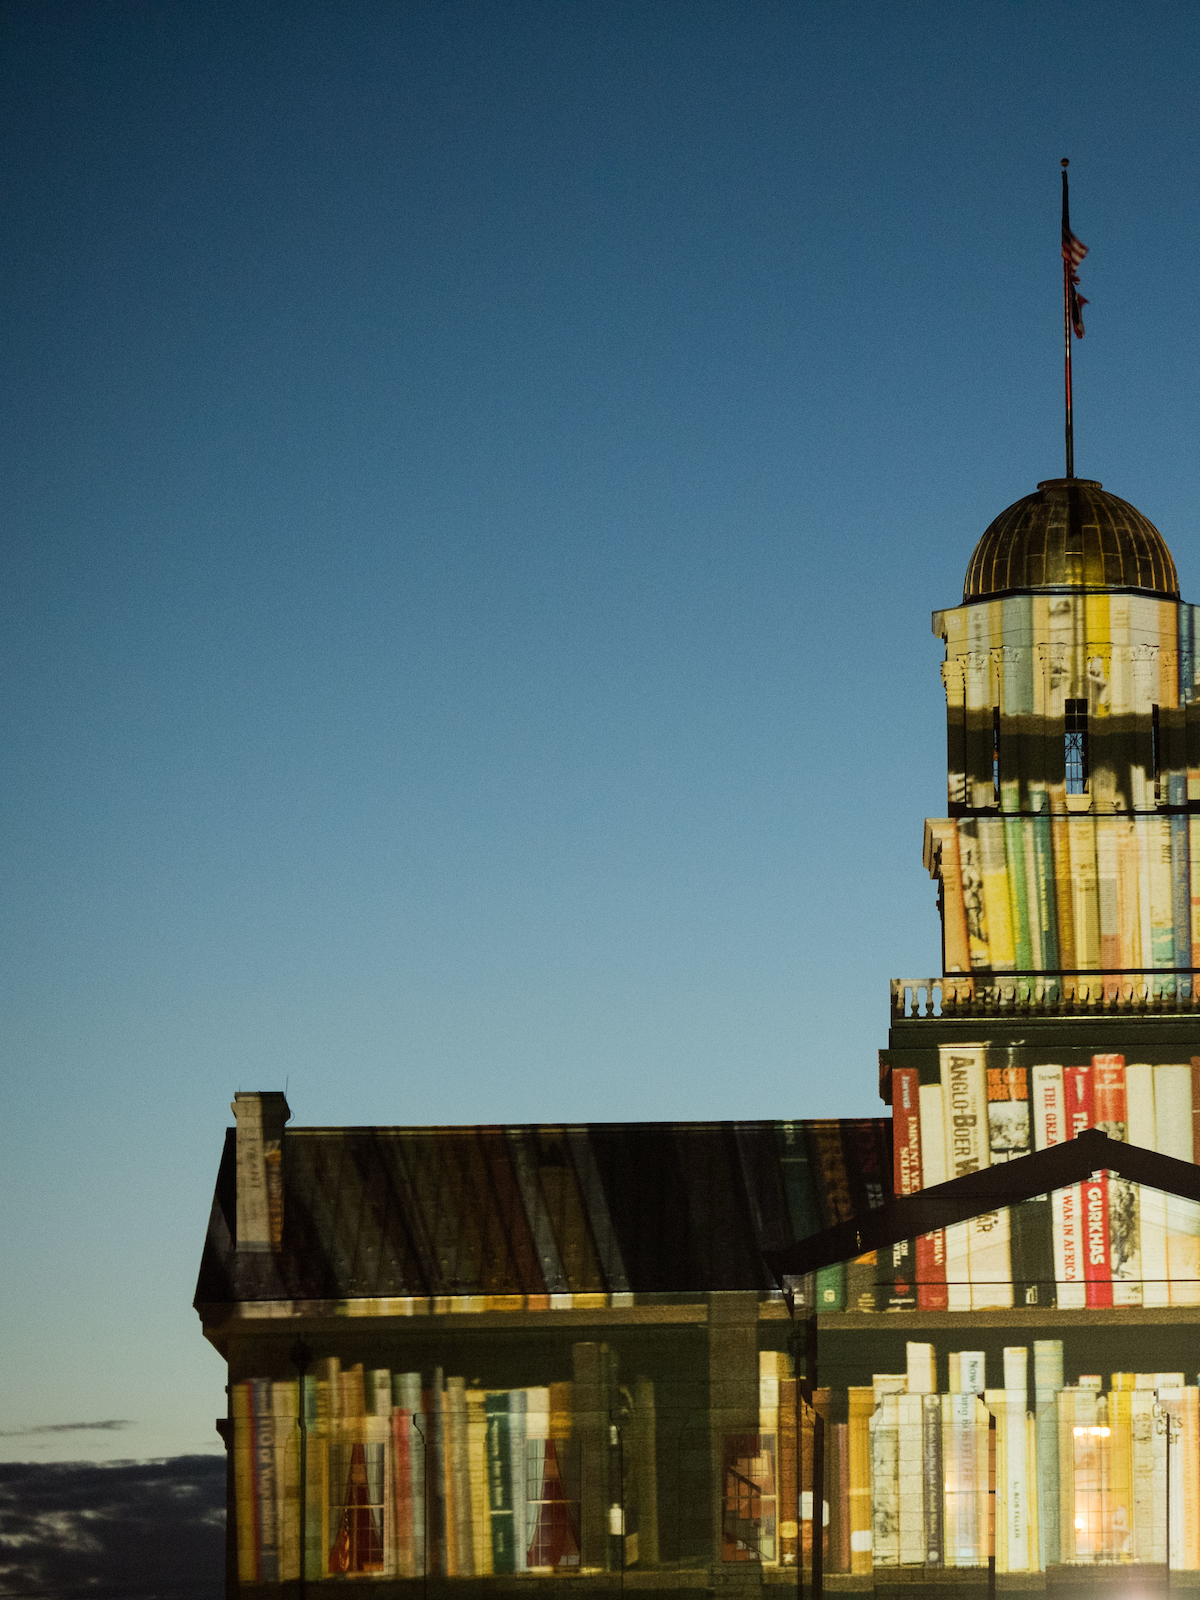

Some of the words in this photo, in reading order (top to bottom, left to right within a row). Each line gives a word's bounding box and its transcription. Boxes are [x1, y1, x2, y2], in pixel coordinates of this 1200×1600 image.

[1044, 1086, 1056, 1110] THE
[1063, 1223, 1075, 1236] IN
[1087, 1188, 1105, 1265] GURKHAS
[1064, 1239, 1076, 1281] AFRICA
